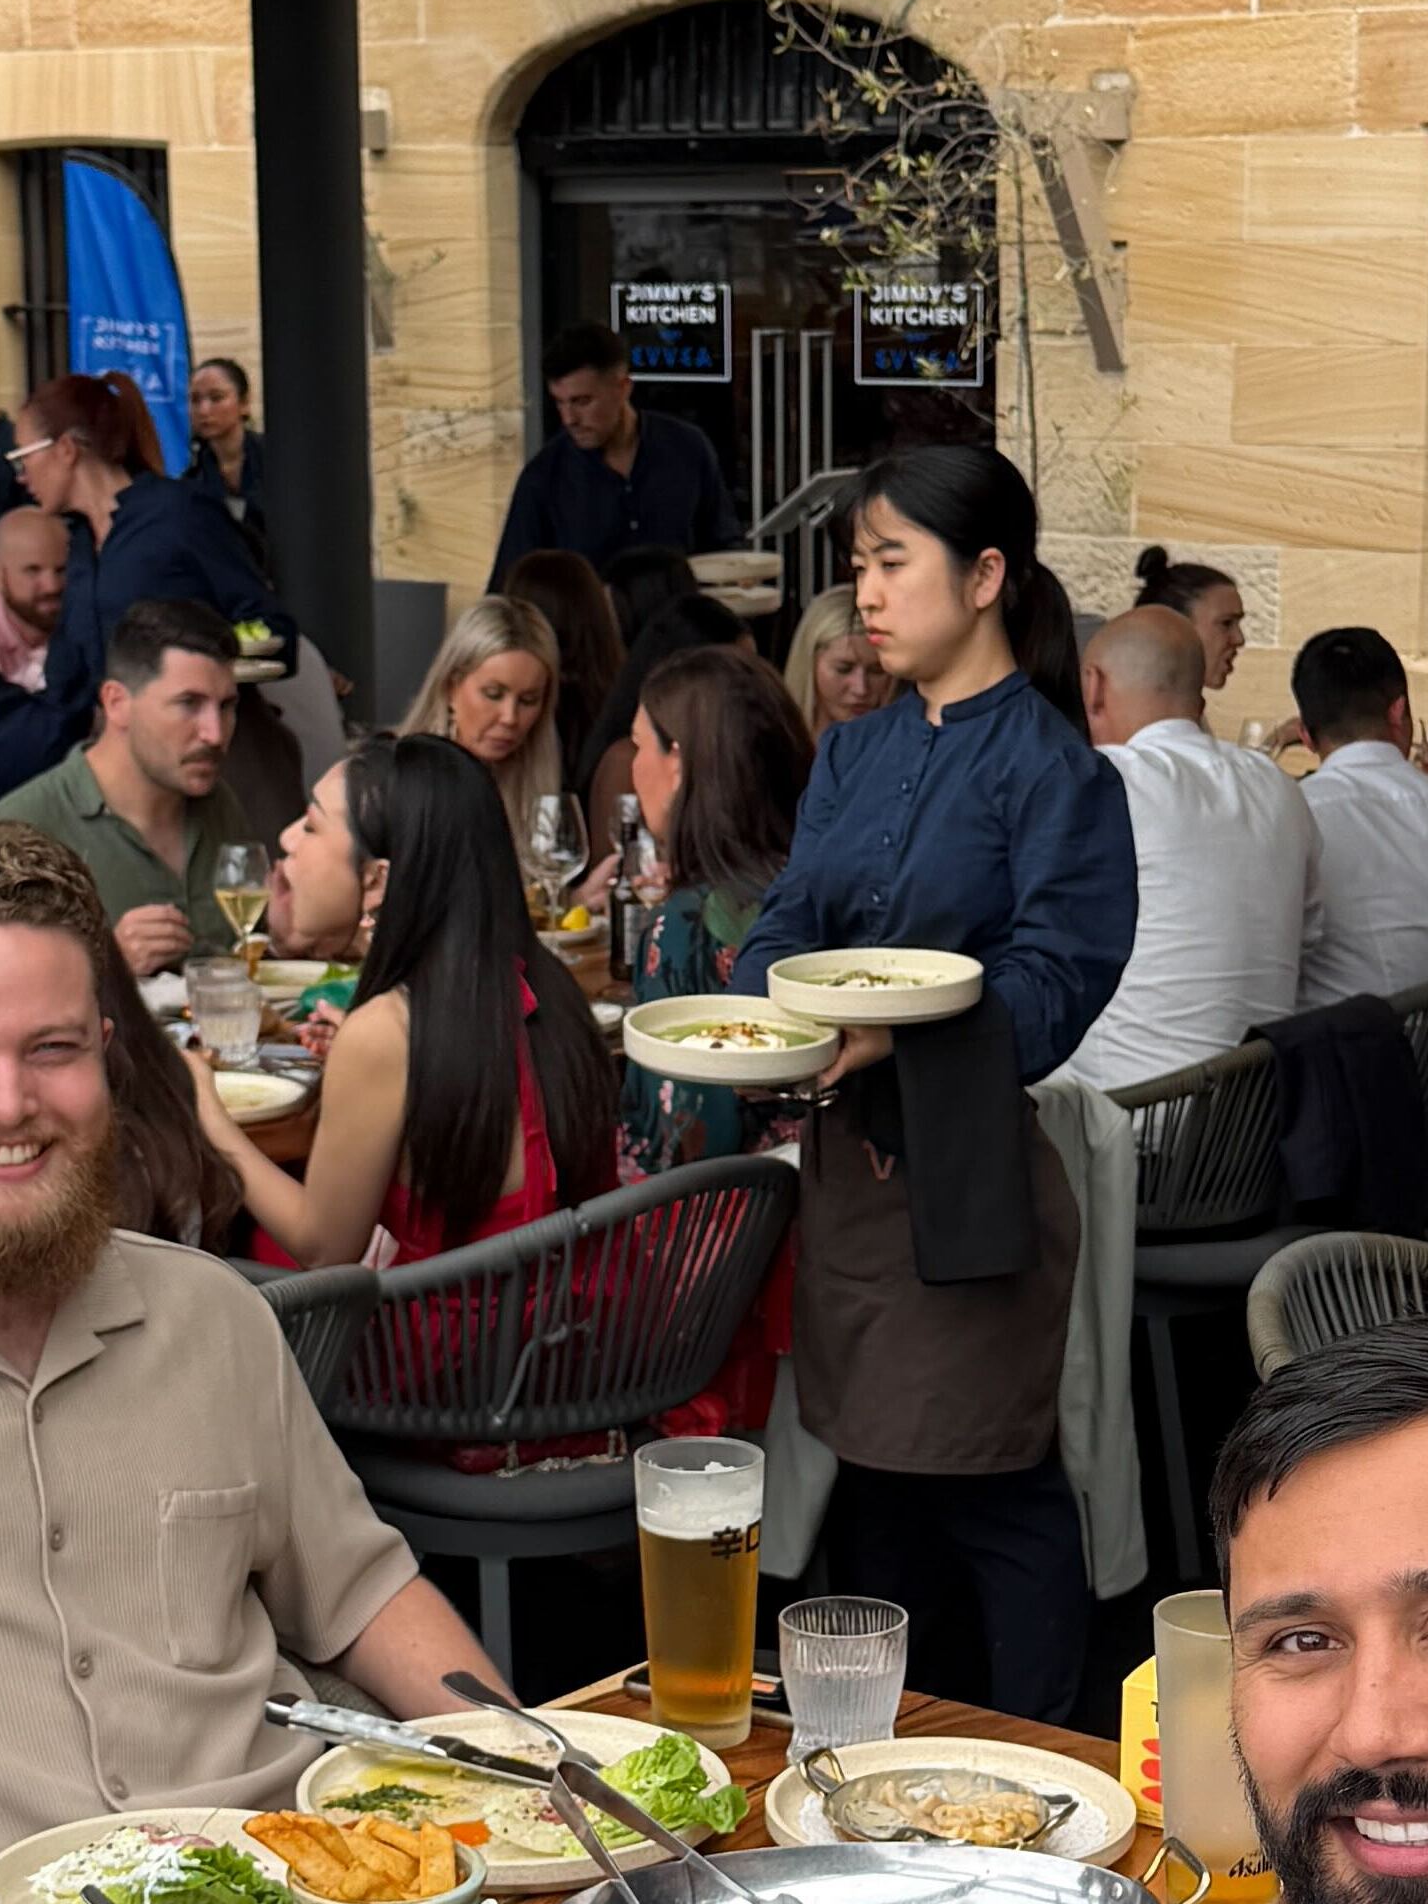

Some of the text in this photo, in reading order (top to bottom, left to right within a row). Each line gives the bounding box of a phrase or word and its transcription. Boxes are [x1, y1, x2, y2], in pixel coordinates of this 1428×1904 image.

[626, 282, 716, 303] JIMMY'S
[870, 282, 968, 303] JIMMY'S
[626, 305, 716, 324] KITCHEN
[870, 306, 968, 326] KITCHEN
